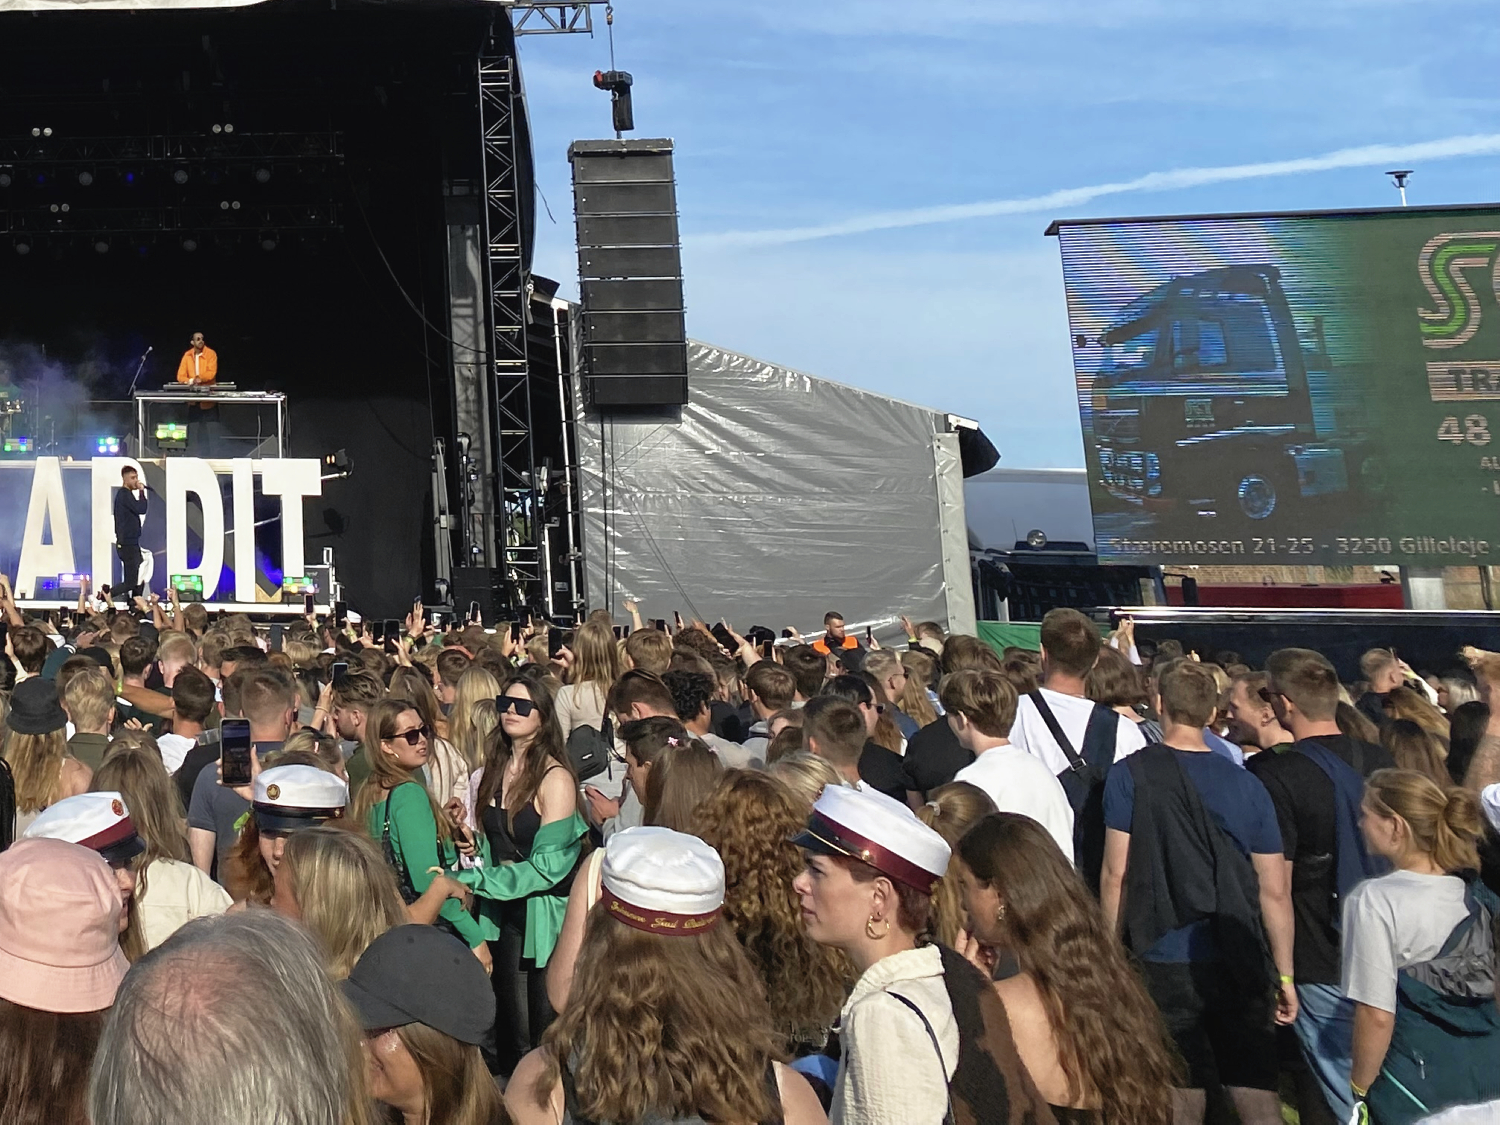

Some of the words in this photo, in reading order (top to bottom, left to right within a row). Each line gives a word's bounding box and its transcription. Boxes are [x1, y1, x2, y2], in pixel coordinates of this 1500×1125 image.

[1437, 414, 1492, 447] 48
[1251, 537, 1314, 555] 21-25
[1335, 537, 1392, 555] 3250
